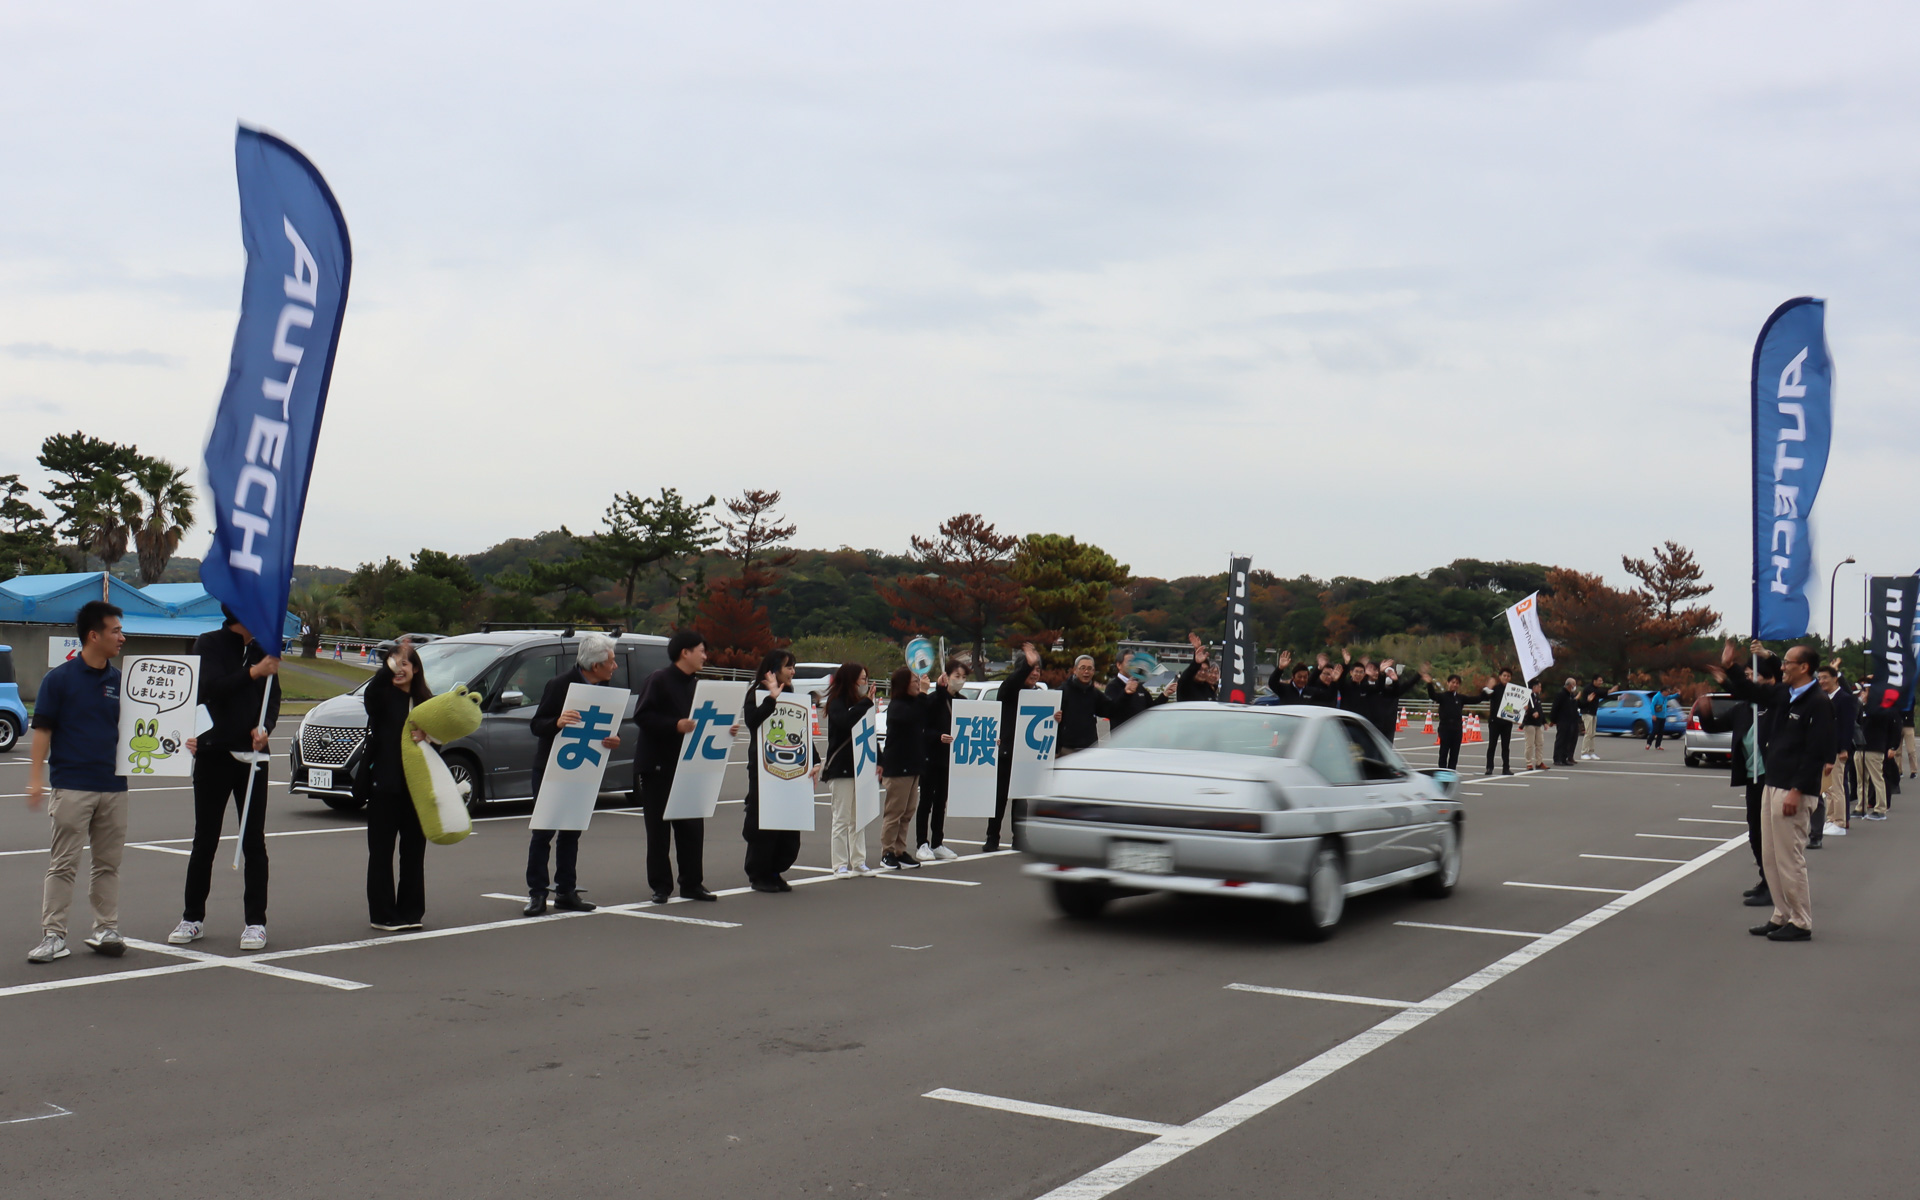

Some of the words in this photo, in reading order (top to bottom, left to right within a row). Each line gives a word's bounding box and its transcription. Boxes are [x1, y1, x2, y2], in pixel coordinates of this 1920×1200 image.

[229, 213, 319, 576] AUTECH
[140, 662, 186, 676] また大磯で
[146, 675, 174, 687] お会い
[556, 704, 614, 770] ま
[682, 700, 736, 761] た
[855, 717, 876, 777] 大
[953, 716, 998, 767] 磯
